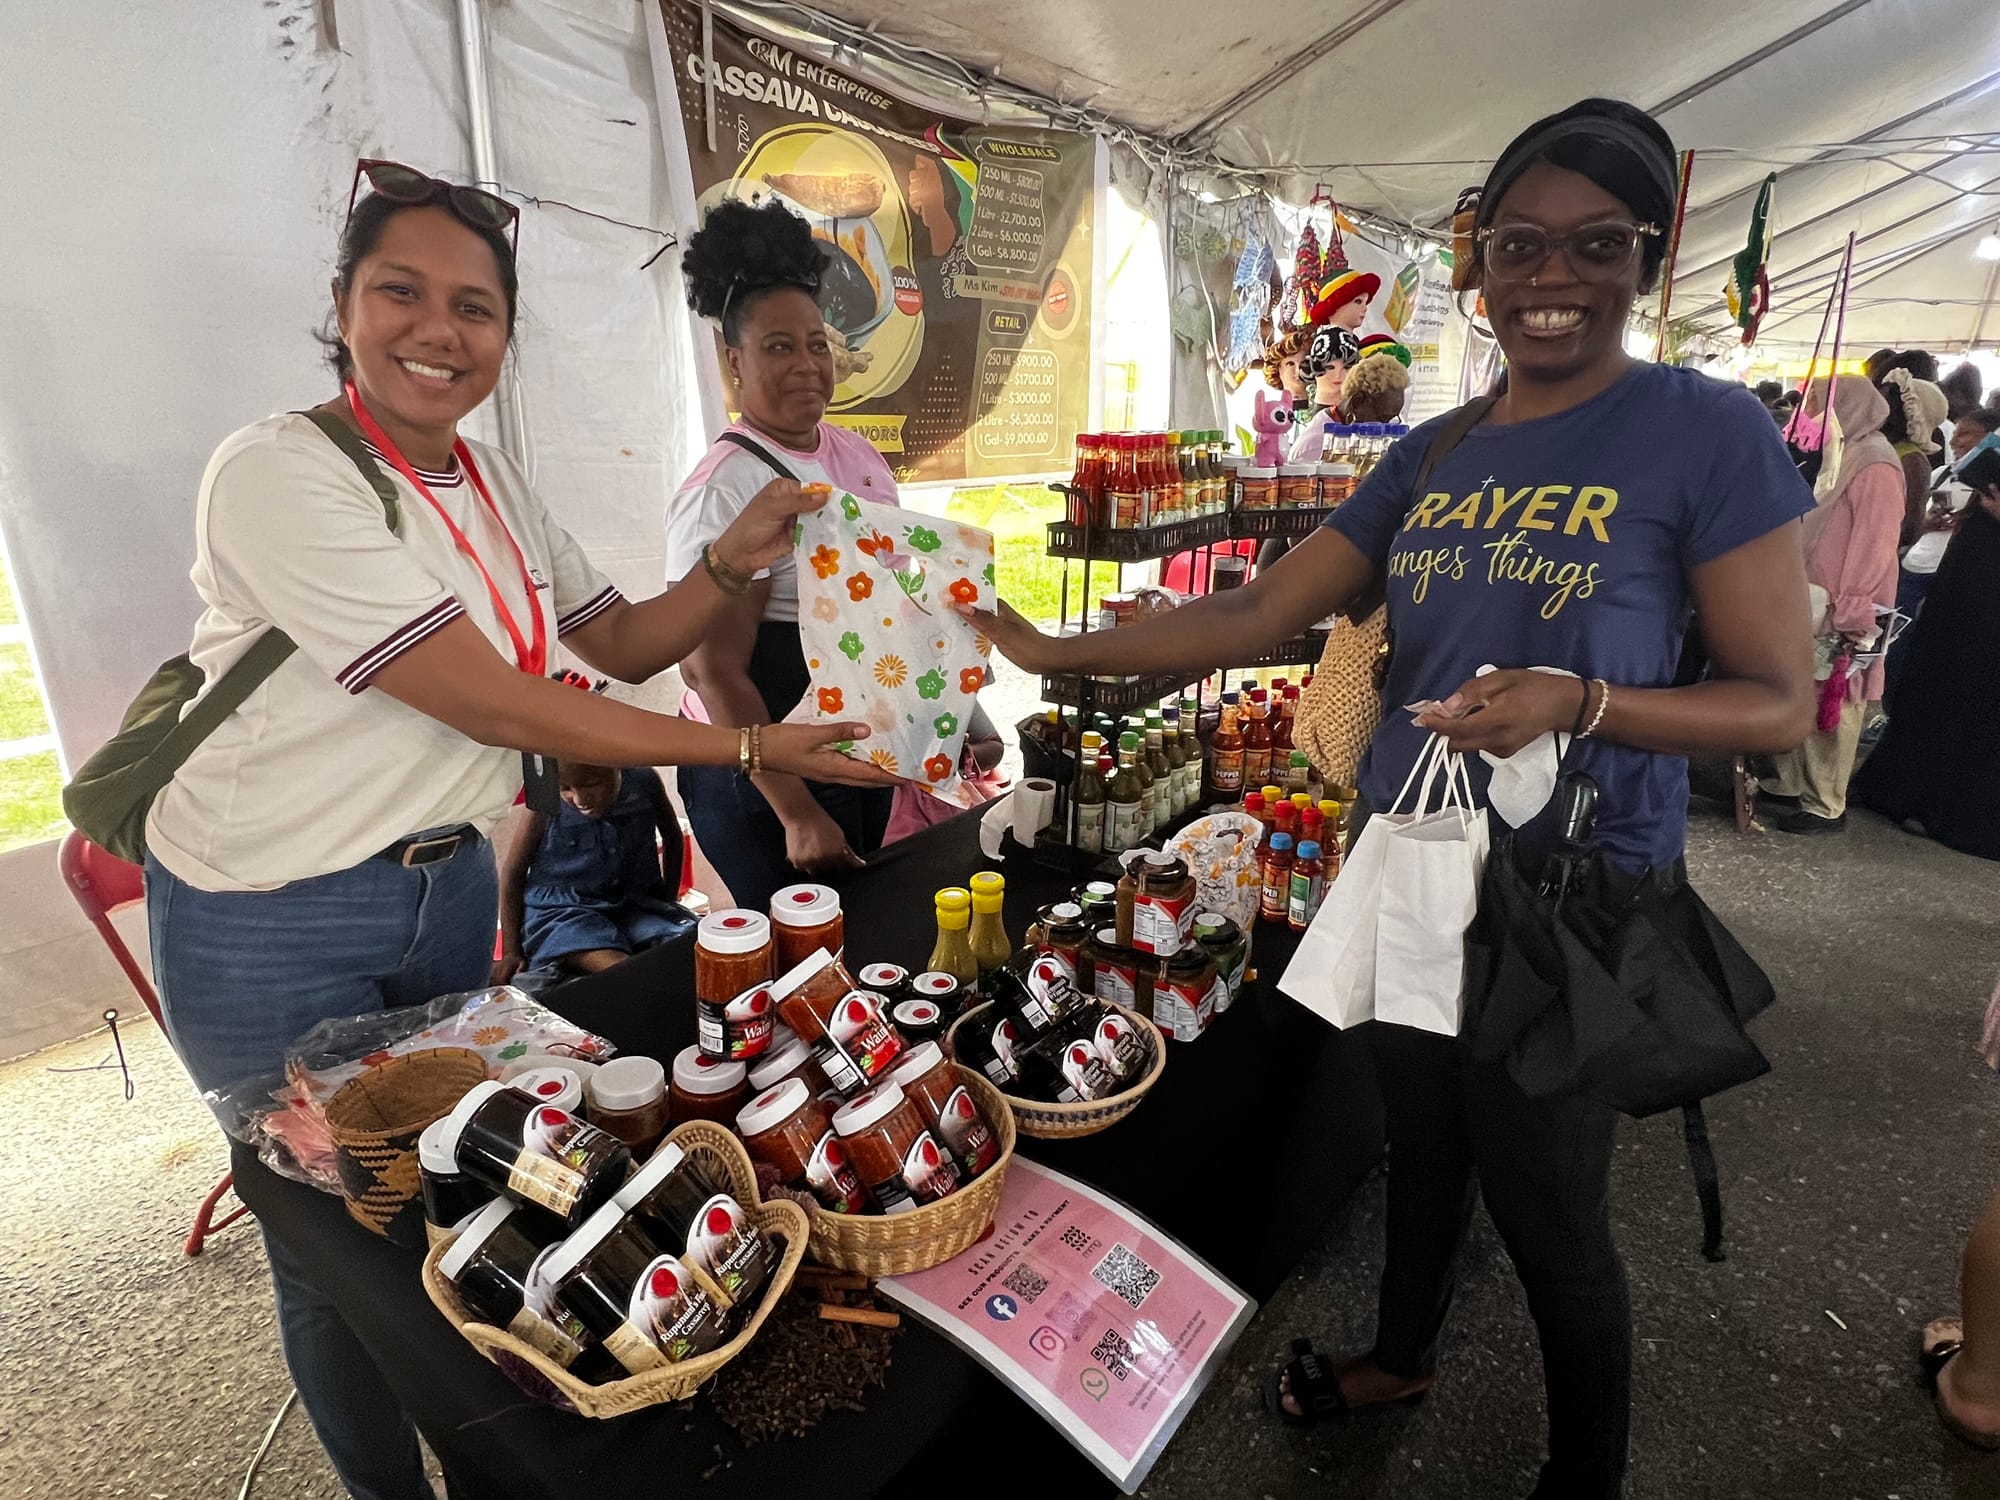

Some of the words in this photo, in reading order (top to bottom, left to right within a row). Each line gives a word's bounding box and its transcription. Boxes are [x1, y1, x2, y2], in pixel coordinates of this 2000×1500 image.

[687, 53, 820, 118] CASSAVA
[796, 60, 894, 111] ENTERPRISE
[988, 142, 1057, 159] WHOLESALE
[984, 166, 1000, 180] 250
[979, 184, 995, 199] 500
[971, 225, 977, 236] 2
[977, 225, 993, 240] Litre
[893, 275, 918, 290] 100%
[964, 279, 979, 291] Ms
[981, 280, 999, 293] Kim
[994, 315, 1021, 330] RETAIL
[987, 353, 1001, 366] 250
[1016, 354, 1053, 369] $900.00
[984, 372, 998, 385] 500
[1014, 372, 1055, 387] $1700.00
[1008, 391, 1052, 405] $3000.00
[977, 414, 984, 426] 2
[984, 413, 1004, 426] Litre
[1010, 413, 1054, 427] $6,300.00
[851, 425, 900, 442] VORS
[1004, 432, 1049, 446] $9,000.00
[1402, 484, 1619, 544] RAYER
[1388, 545, 1473, 605] anges
[968, 1252, 996, 1276] SCAN
[1023, 1209, 1039, 1221] TO
[714, 1234, 750, 1277] Rupununi's
[958, 1296, 974, 1310] SEE
[972, 1281, 988, 1297] OUR
[986, 1249, 1020, 1284] PRODUCTS
[660, 1295, 699, 1344] Rupununi's
